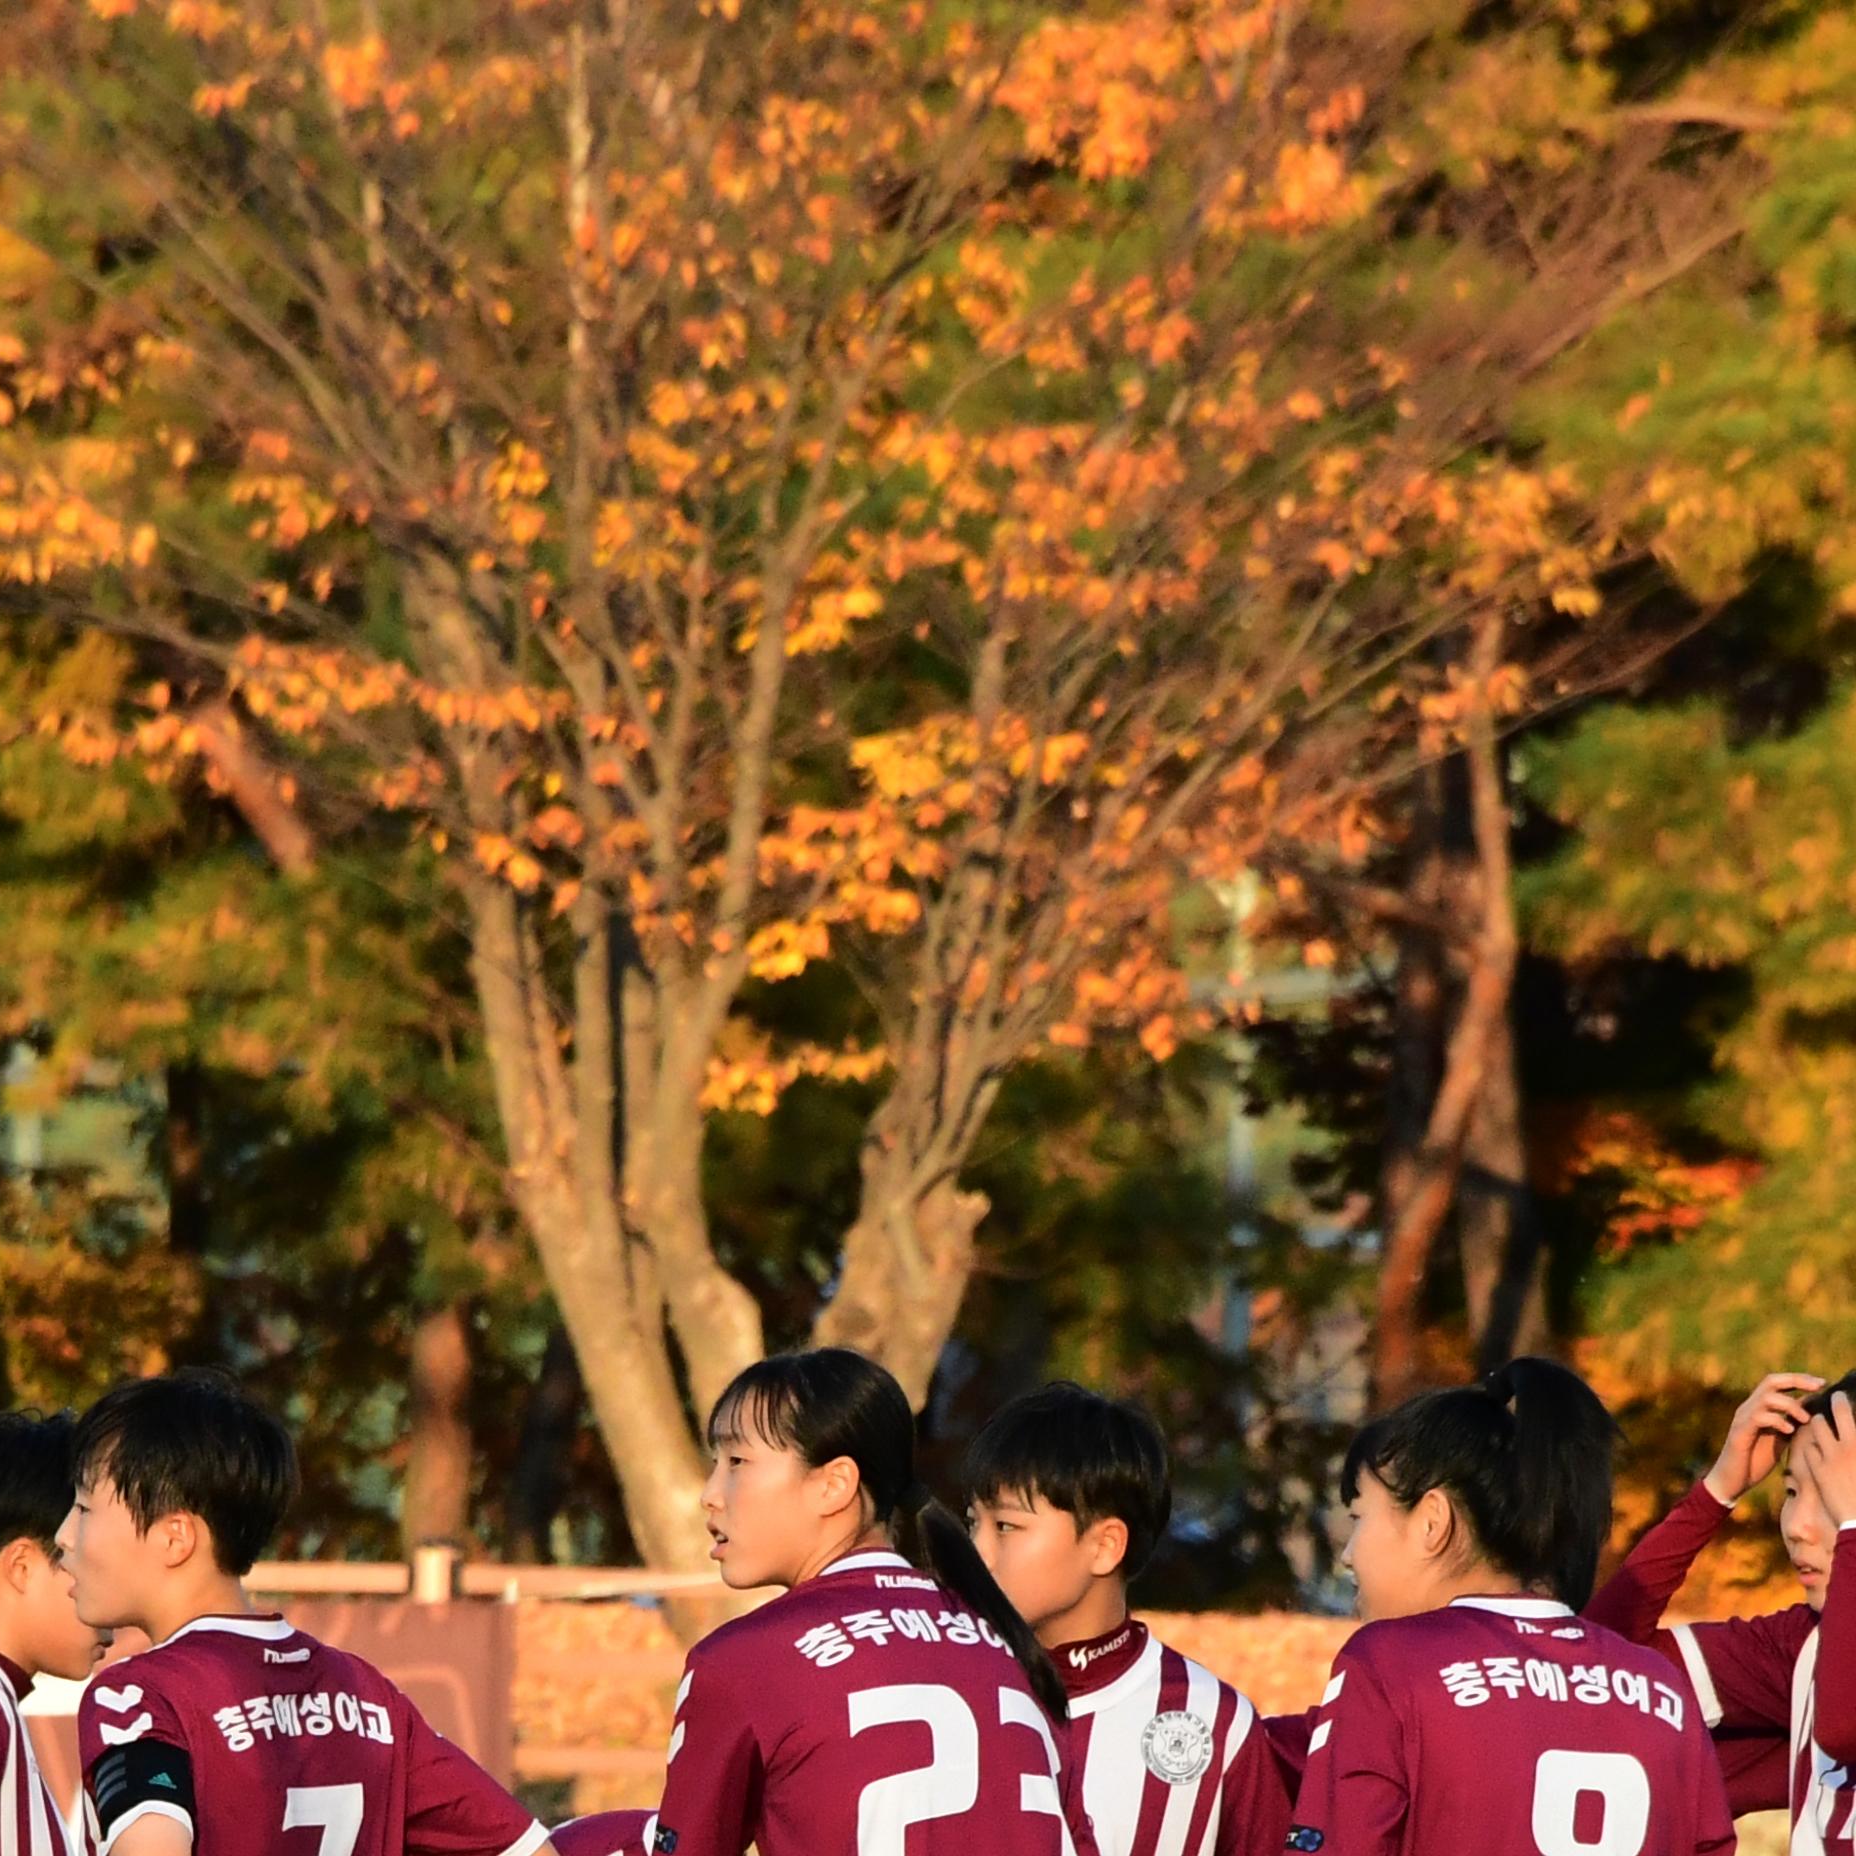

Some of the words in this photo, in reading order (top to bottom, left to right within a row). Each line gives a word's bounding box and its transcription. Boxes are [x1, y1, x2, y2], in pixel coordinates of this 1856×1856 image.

[794, 1608, 1016, 1668] 충주예성
[212, 1691, 395, 1753] 충주예성여고
[1439, 1657, 1684, 1732] 충주예성여고
